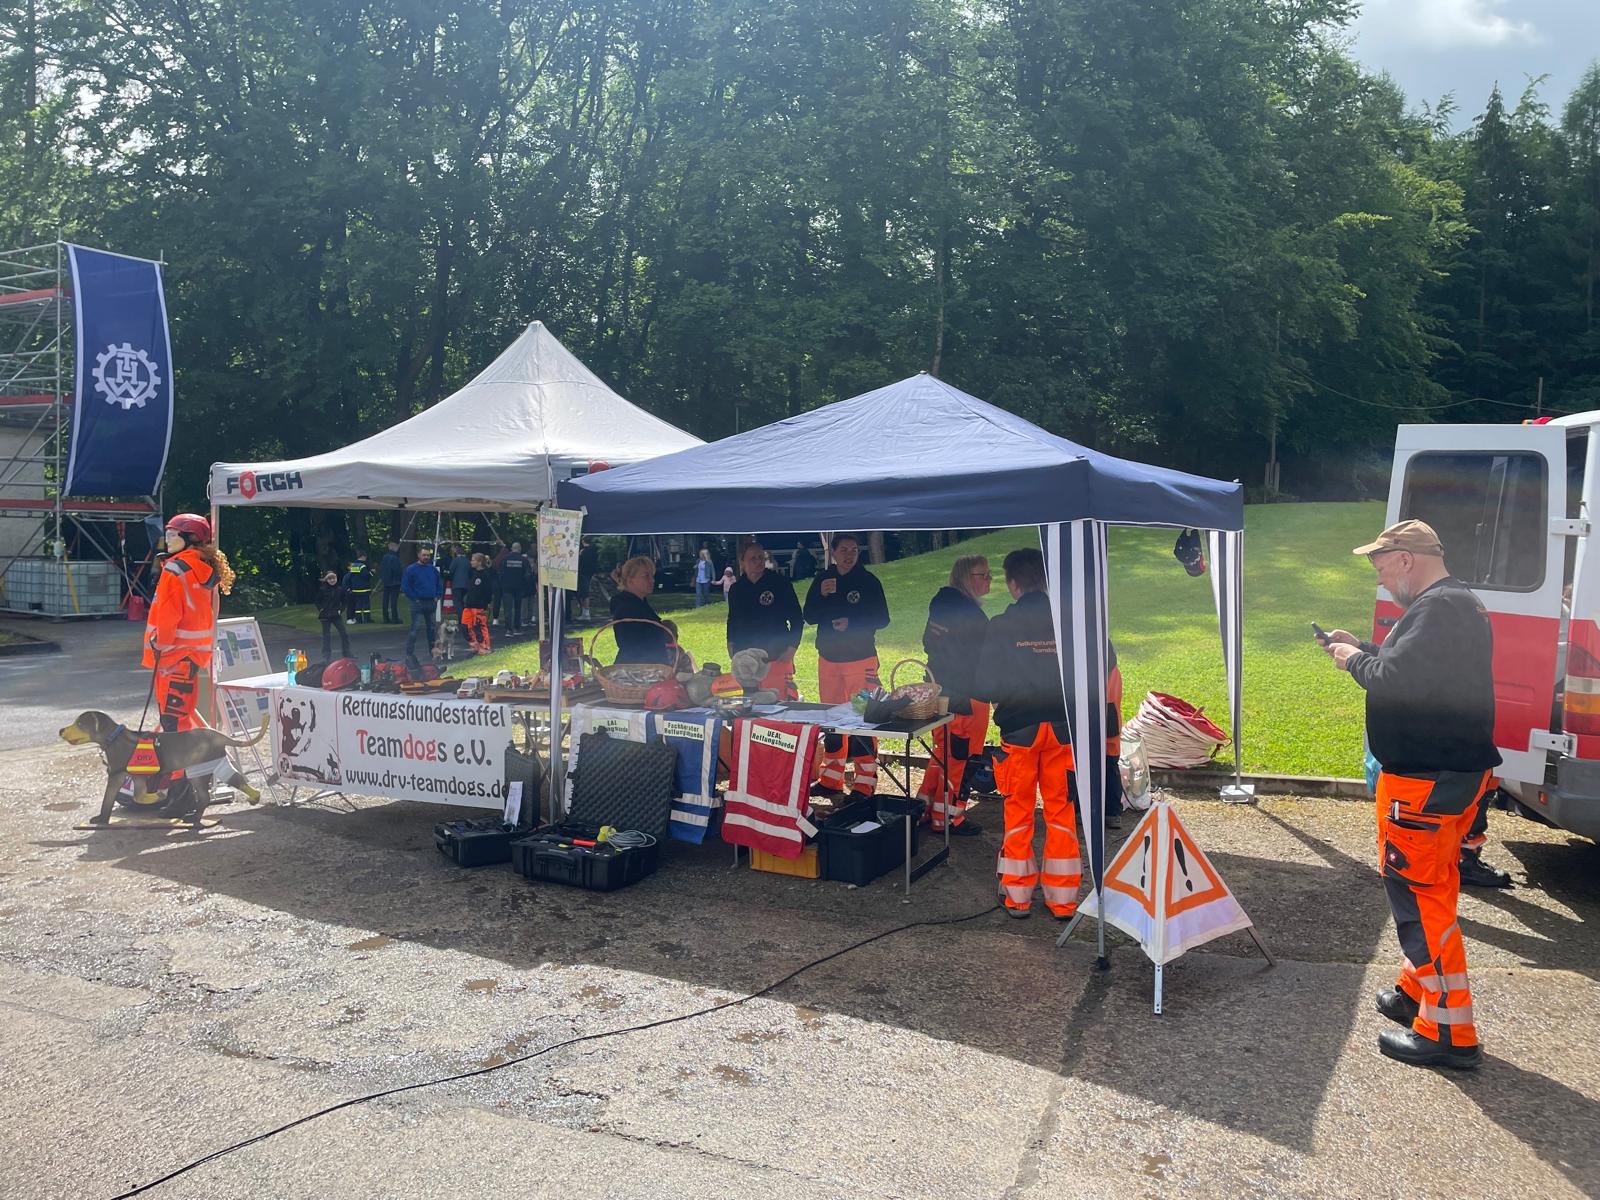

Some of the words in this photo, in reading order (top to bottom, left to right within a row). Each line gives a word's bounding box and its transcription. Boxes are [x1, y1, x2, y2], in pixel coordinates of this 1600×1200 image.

[342, 695, 506, 727] Rettungshundestaffel
[356, 729, 448, 762] Teamdogs
[454, 739, 492, 766] e.V.
[751, 732, 795, 750] Rettungshunde
[346, 769, 508, 799] www.drv-teamdogs.de
